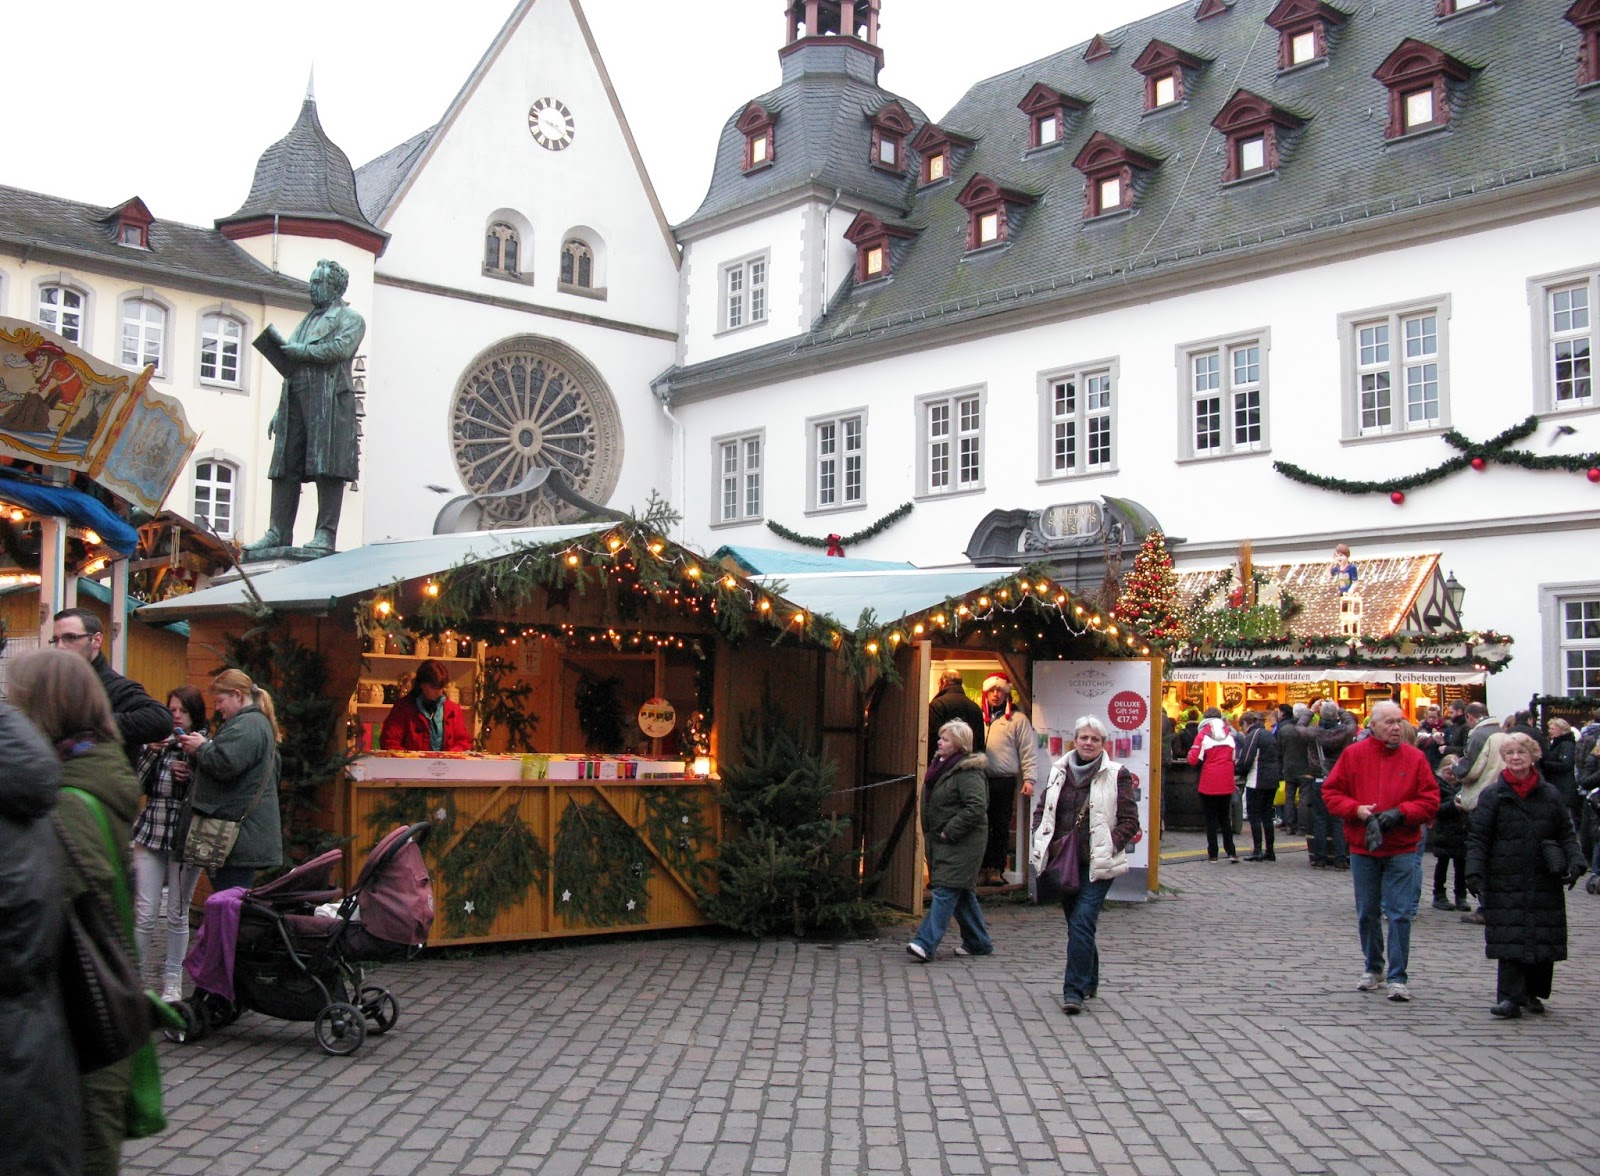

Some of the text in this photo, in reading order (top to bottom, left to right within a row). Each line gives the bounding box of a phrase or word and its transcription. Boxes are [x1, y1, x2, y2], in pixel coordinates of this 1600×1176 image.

[934, 161, 942, 176] 9
[870, 253, 881, 270] 13
[1227, 671, 1253, 680] Imbiss
[1395, 672, 1456, 683] Reibekuchen
